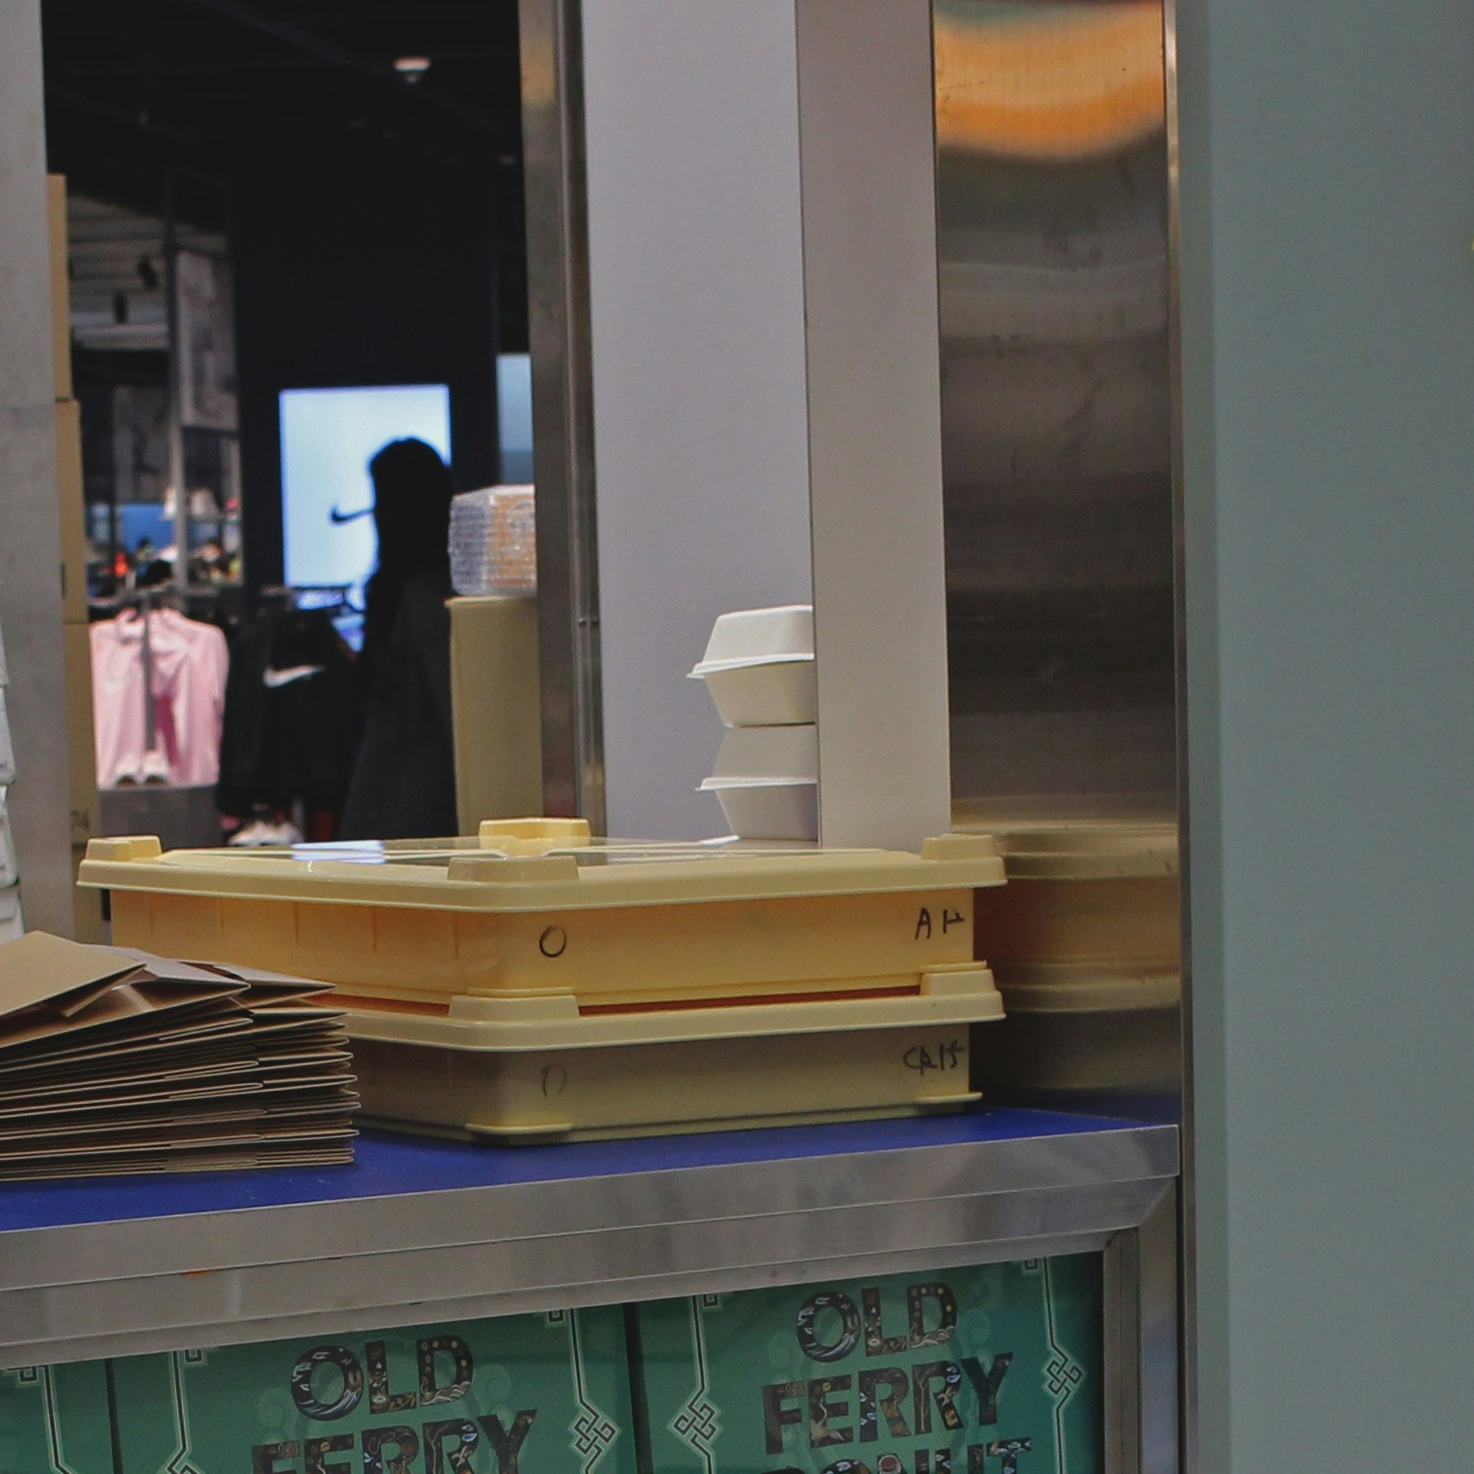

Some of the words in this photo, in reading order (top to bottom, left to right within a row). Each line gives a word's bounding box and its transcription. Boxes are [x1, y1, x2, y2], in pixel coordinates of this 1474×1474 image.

[796, 1281, 958, 1363] OLD
[290, 1334, 474, 1421] OLD
[761, 1352, 1014, 1456] FERRY
